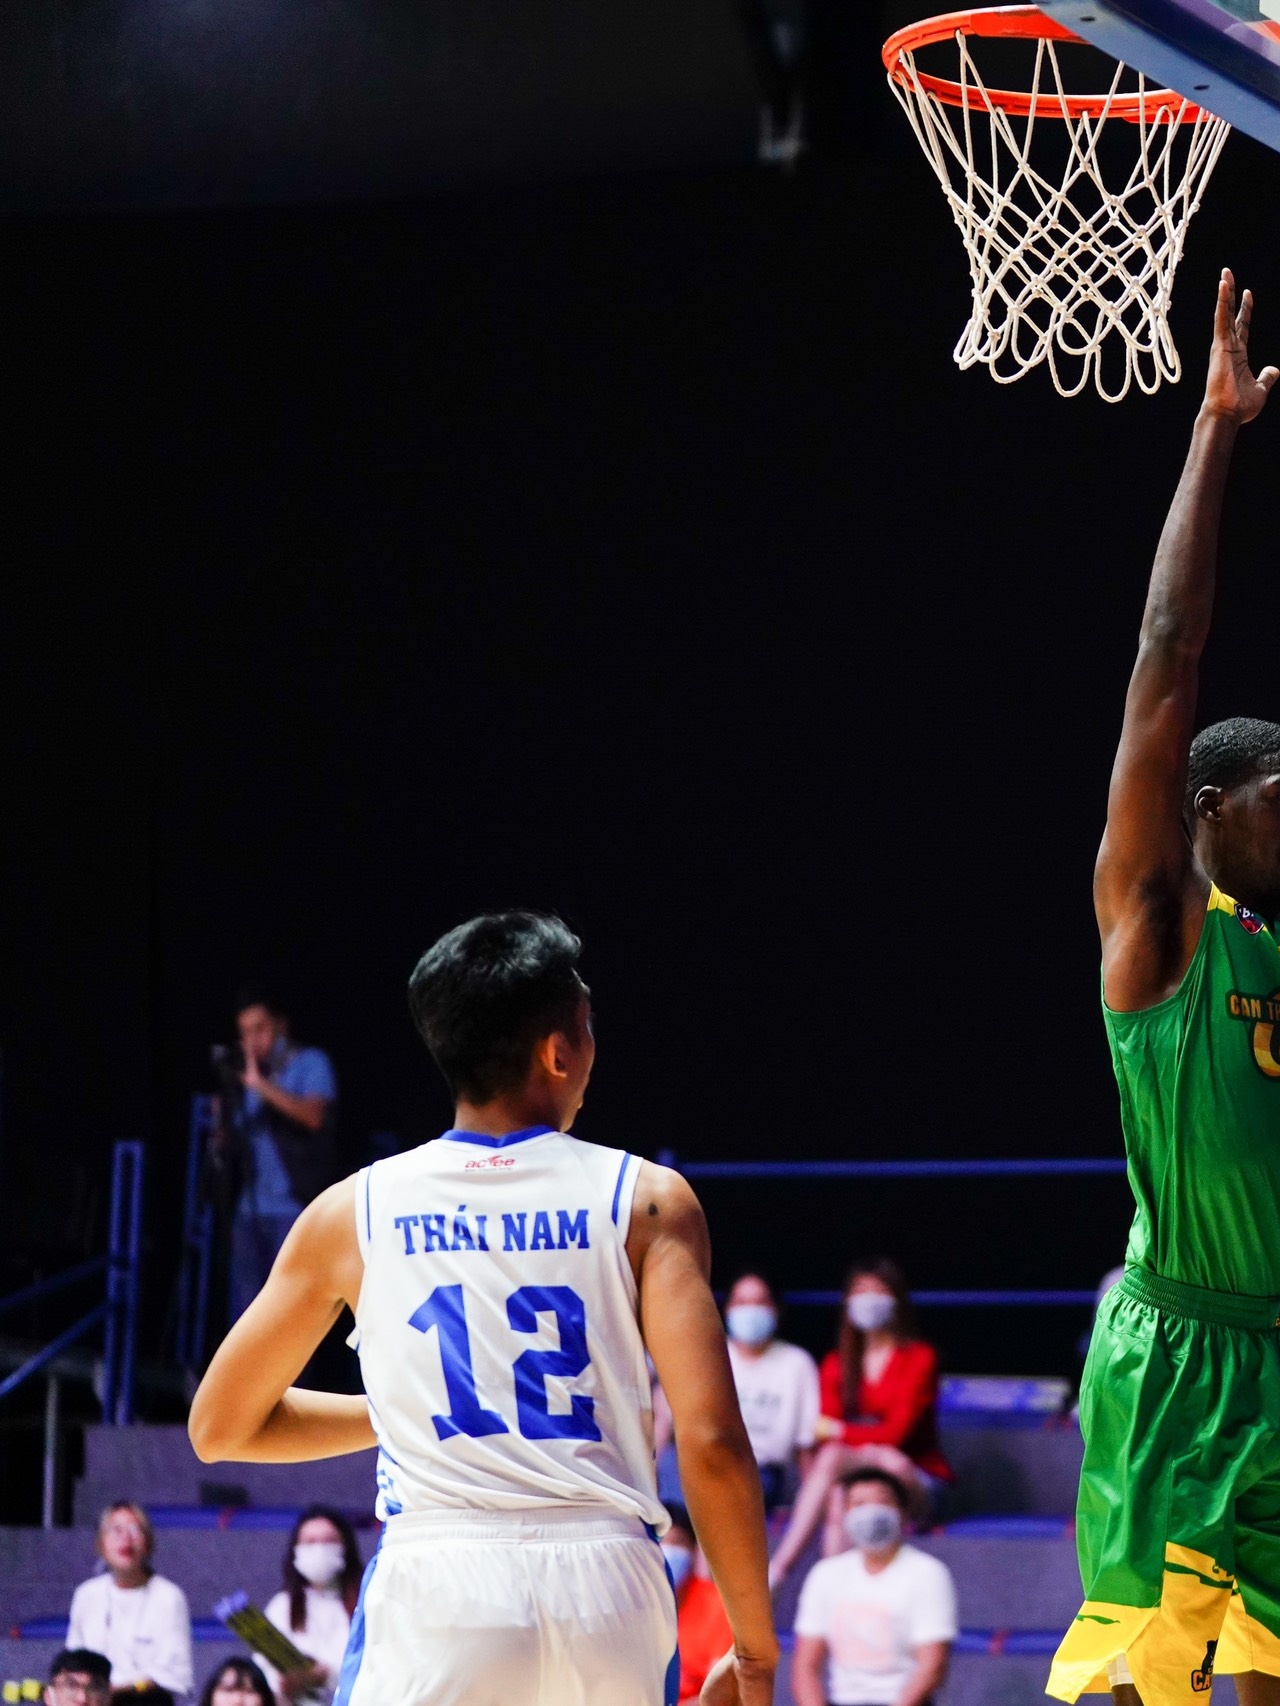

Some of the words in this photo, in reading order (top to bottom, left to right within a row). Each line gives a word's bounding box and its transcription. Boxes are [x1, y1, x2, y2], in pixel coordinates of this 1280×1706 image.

[1230, 994, 1262, 1019] CAN
[394, 1205, 489, 1255] THÁI
[502, 1209, 590, 1251] NAM
[408, 1284, 602, 1442] 12
